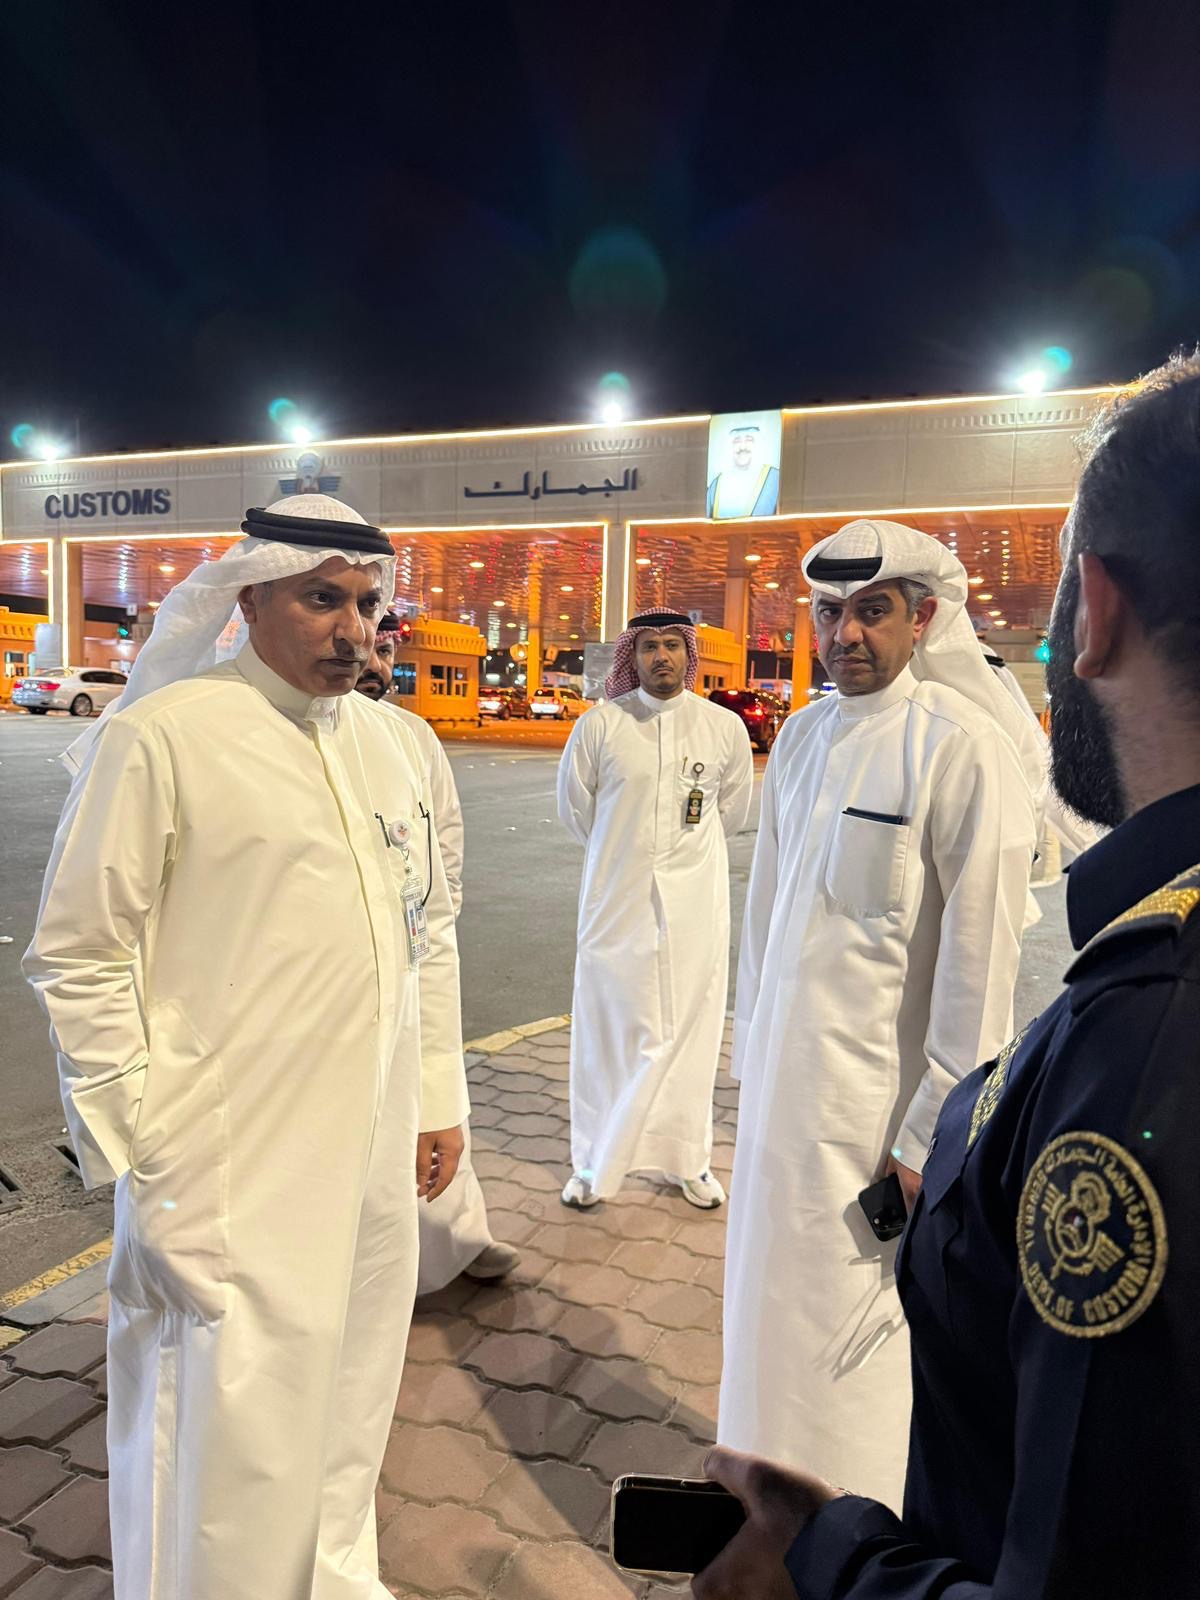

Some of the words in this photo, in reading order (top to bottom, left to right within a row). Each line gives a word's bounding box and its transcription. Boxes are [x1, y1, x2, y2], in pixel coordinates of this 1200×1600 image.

[464, 467, 638, 501] الجمارك
[44, 488, 171, 519] CUSTOMS
[1024, 1168, 1048, 1249] GENERAL
[1055, 1295, 1074, 1321] OF
